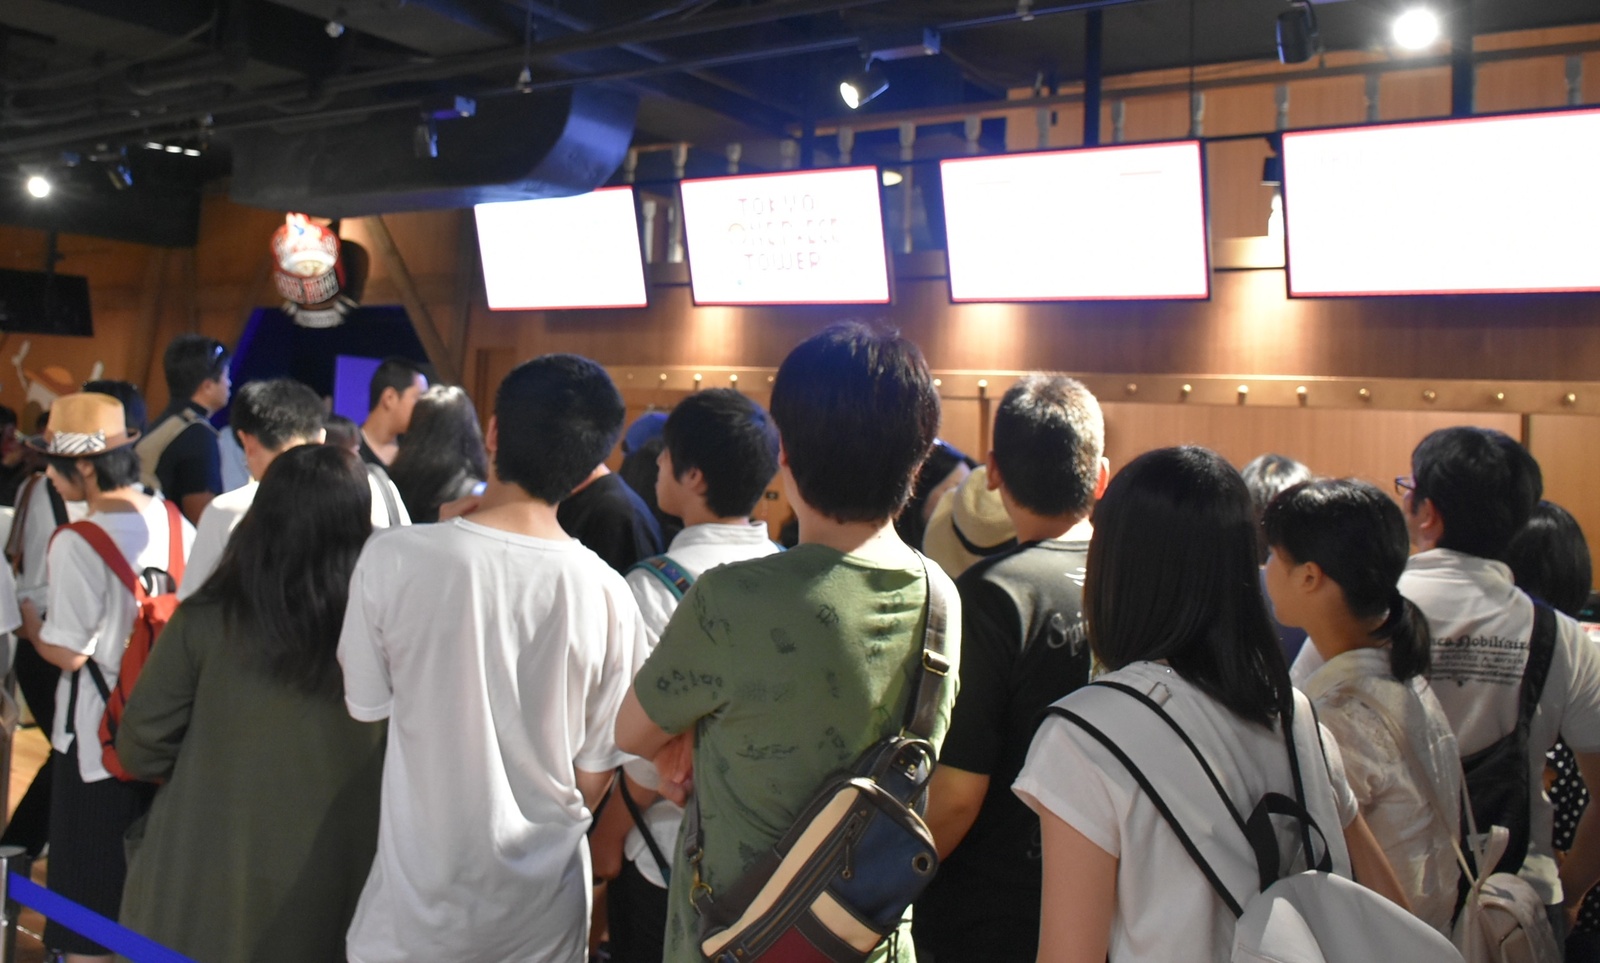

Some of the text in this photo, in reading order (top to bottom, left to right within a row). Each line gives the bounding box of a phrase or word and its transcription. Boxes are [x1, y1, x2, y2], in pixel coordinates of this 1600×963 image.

[738, 194, 815, 216] TOKYO
[744, 251, 820, 271] TOWER
[1457, 634, 1530, 650] Nobiliair
